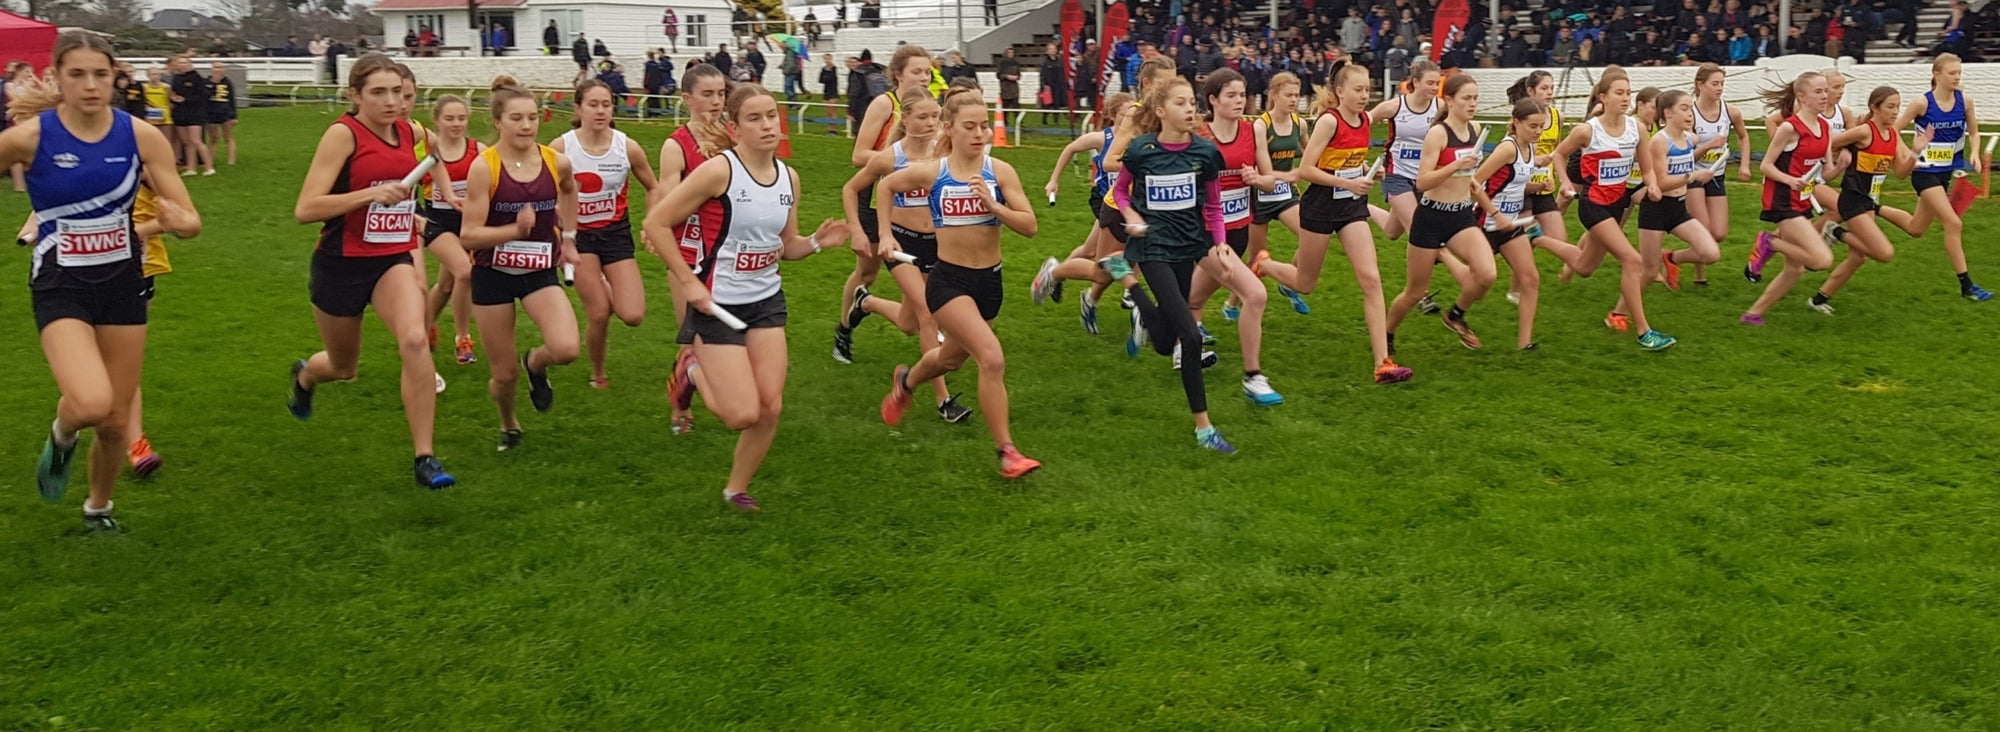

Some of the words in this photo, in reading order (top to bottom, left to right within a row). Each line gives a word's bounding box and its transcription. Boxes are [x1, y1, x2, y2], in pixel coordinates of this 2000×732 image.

[1927, 149, 1952, 160] 91AKL
[1601, 166, 1630, 177] J1CMA
[1668, 161, 1693, 174] J1AKL
[1151, 185, 1191, 200] J1TAS
[577, 200, 613, 214] 1CMA
[944, 199, 988, 214] S1AK
[1221, 197, 1248, 214] 1CAN
[1432, 202, 1458, 212] NIKE
[369, 214, 411, 230] S1CAN
[60, 230, 126, 252] S1WNG
[497, 253, 547, 268] S1STH
